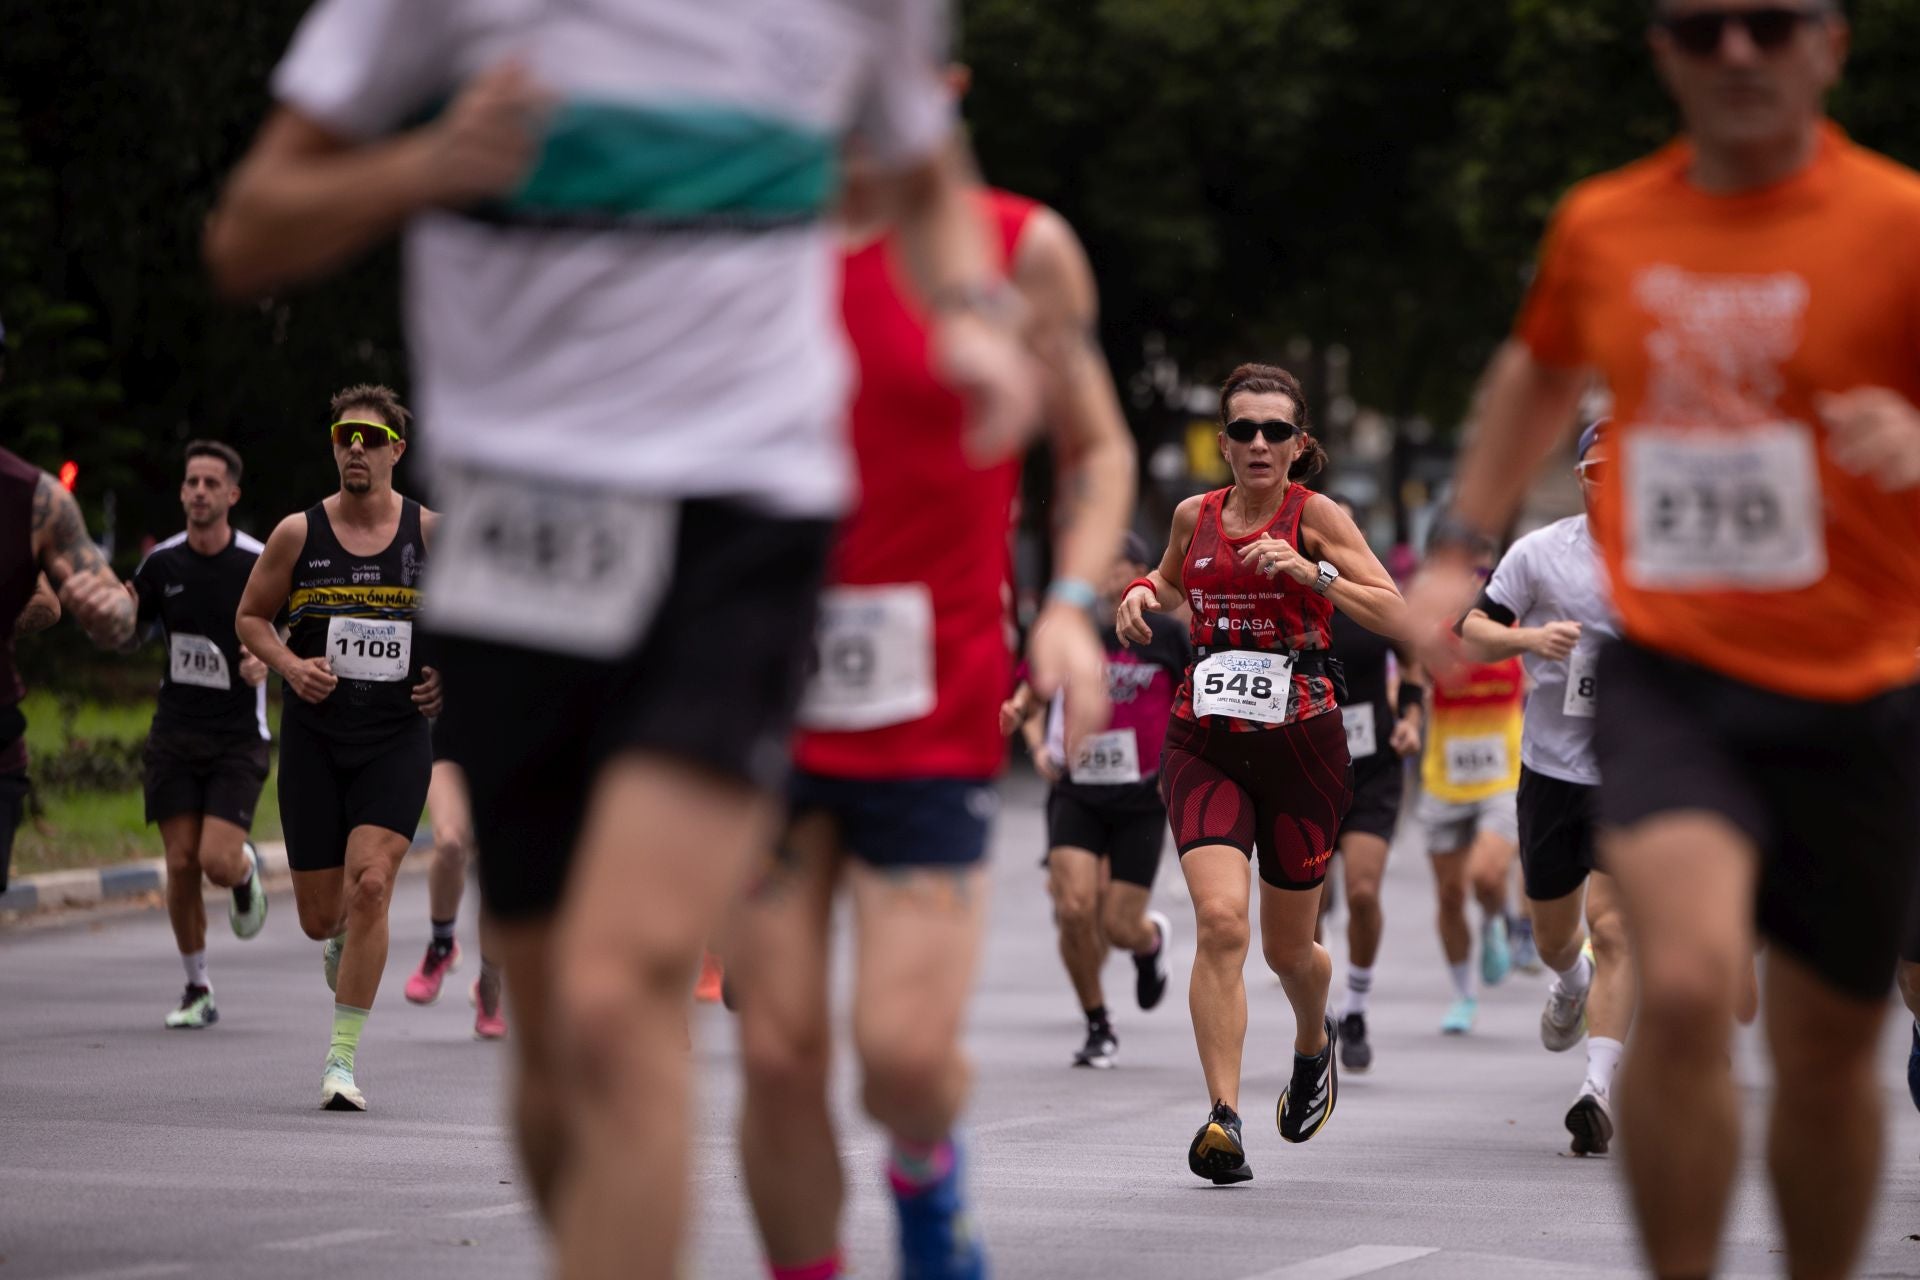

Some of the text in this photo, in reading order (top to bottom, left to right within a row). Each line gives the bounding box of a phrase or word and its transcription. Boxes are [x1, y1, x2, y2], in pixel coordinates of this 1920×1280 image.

[308, 559, 331, 569] vive
[352, 571, 381, 585] gross
[1248, 592, 1257, 600] de
[1231, 618, 1275, 630] CASA
[335, 638, 401, 659] 1108
[1204, 673, 1273, 700] 548
